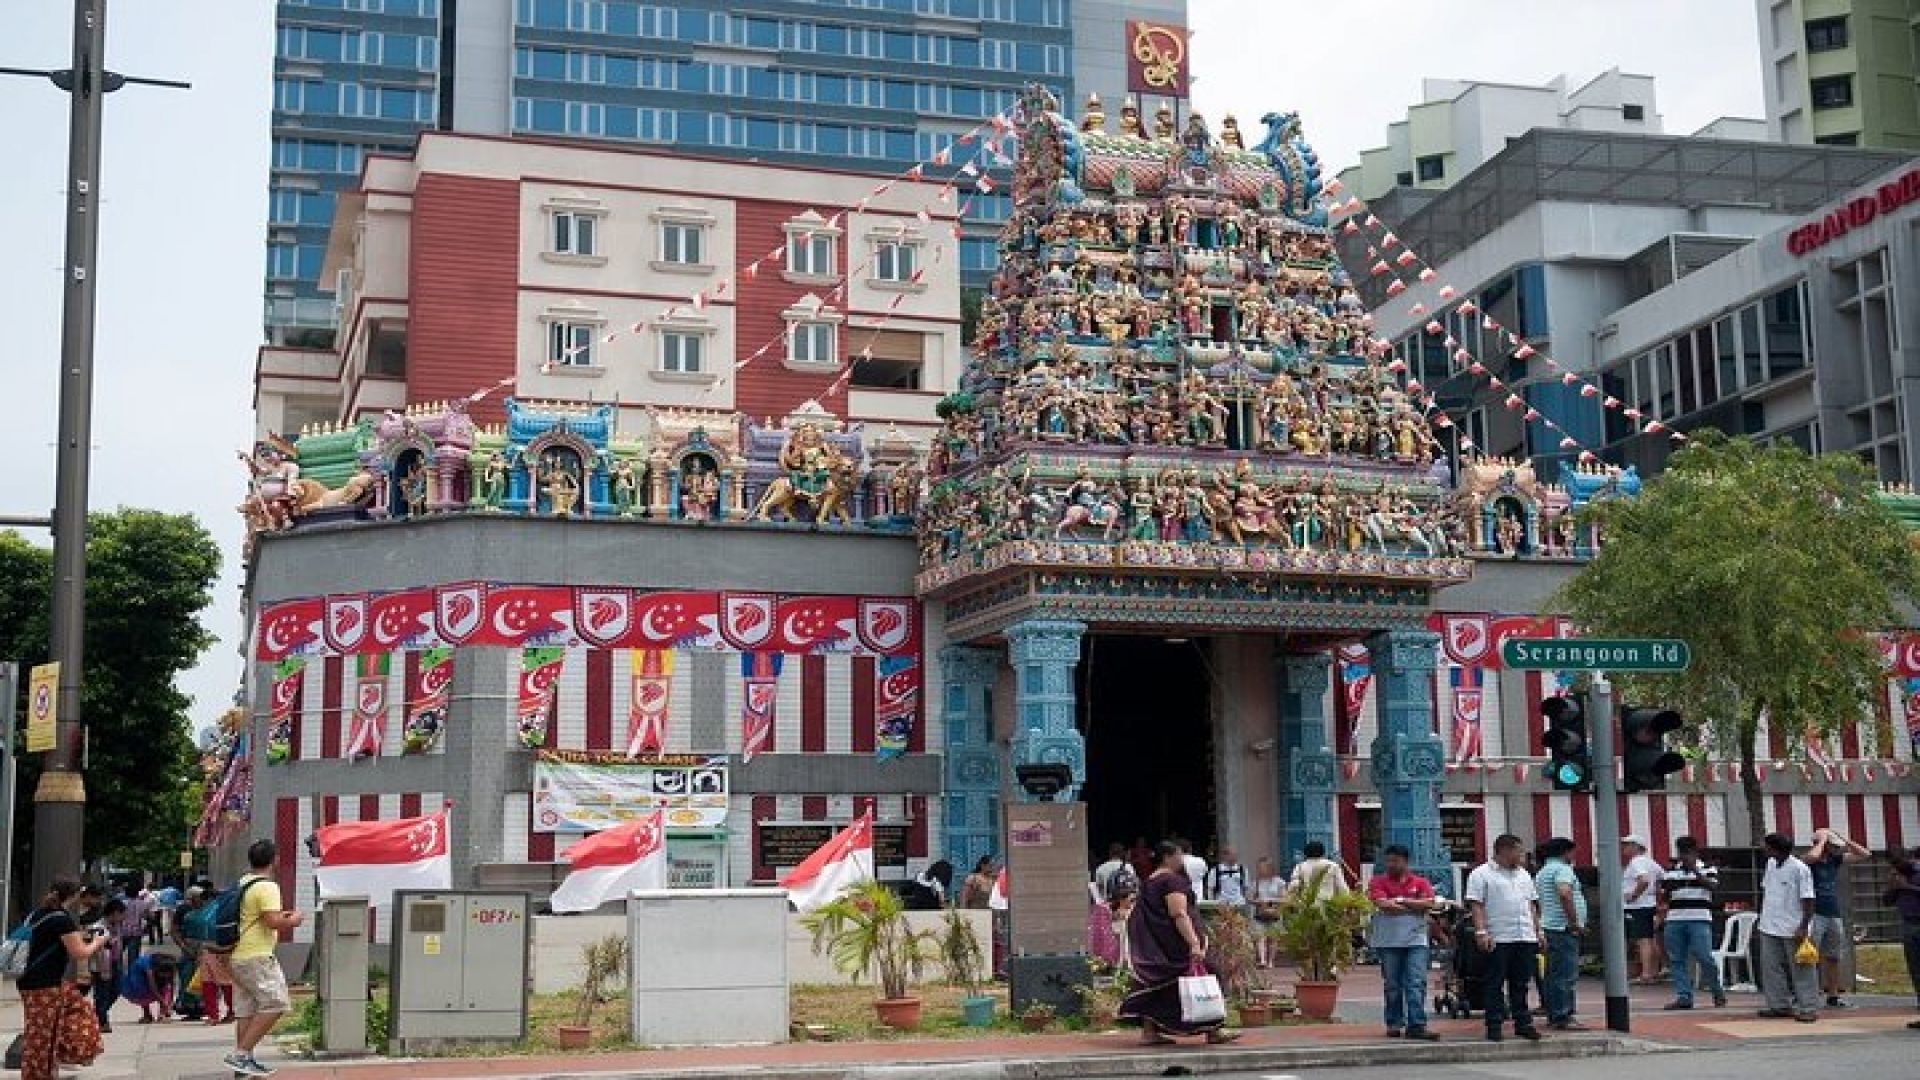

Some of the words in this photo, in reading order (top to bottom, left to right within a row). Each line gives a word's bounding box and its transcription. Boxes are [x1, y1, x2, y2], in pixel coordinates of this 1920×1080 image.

[1787, 197, 1876, 256] GRAND
[1515, 643, 1638, 666] Serangoon
[1652, 643, 1679, 662] Rd
